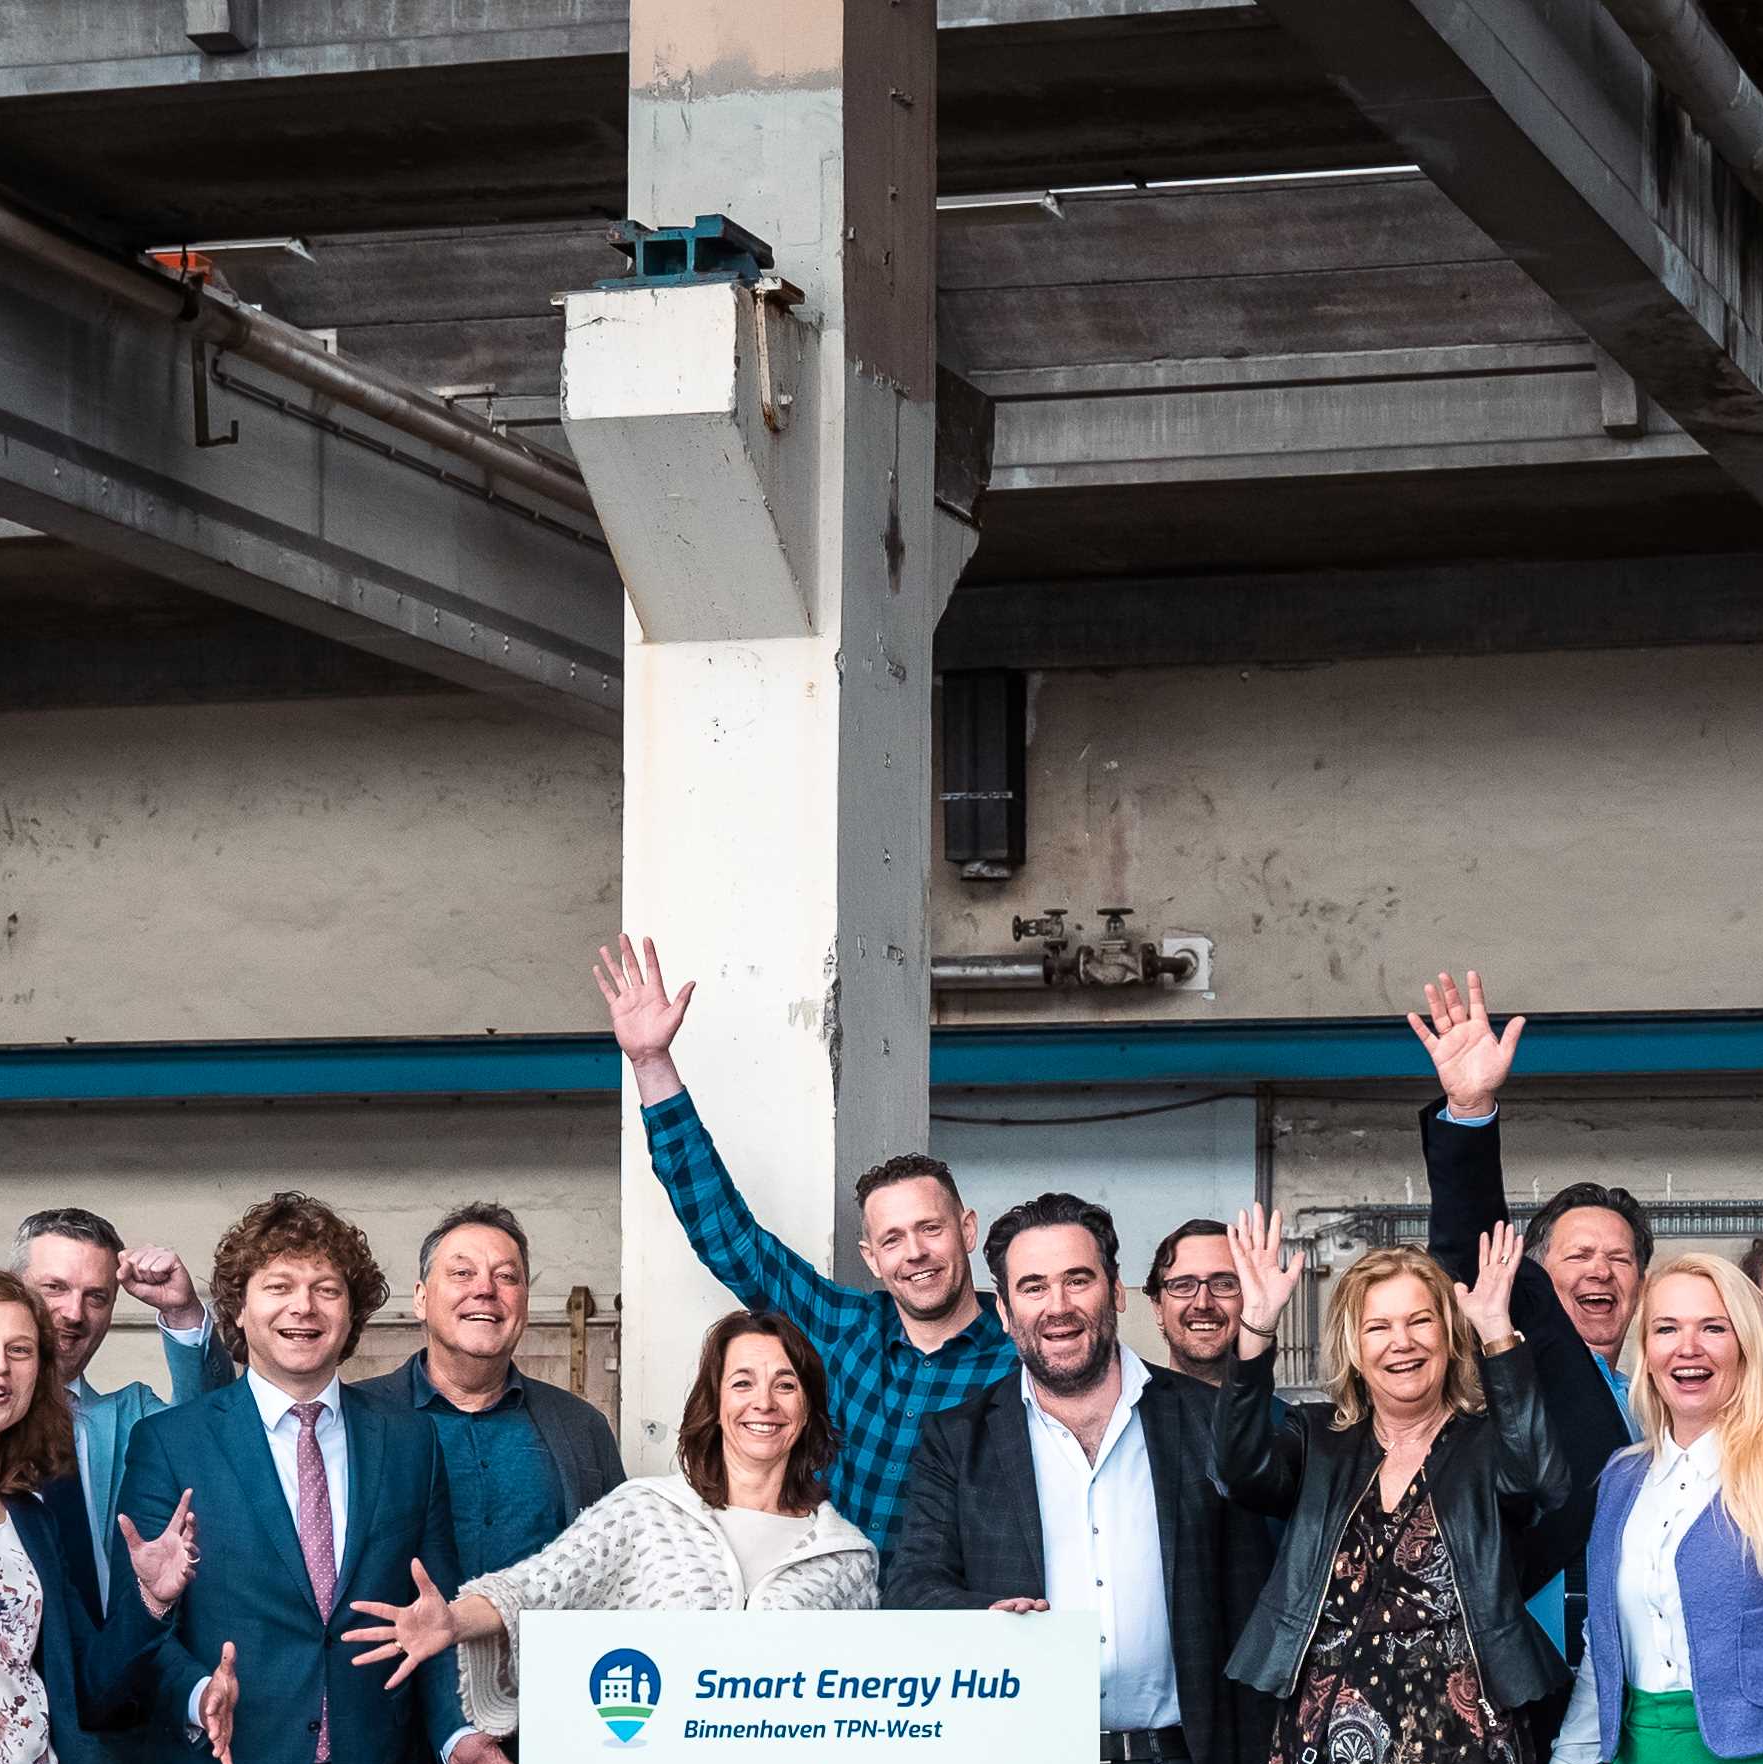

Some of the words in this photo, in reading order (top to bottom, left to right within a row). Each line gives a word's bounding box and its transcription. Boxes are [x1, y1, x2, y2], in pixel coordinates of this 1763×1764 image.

[695, 1669, 806, 1699] Smart
[816, 1669, 941, 1707] Energy
[951, 1668, 1020, 1699] Hub
[684, 1719, 826, 1738] Binnenhaven
[834, 1719, 943, 1738] TPN-West
